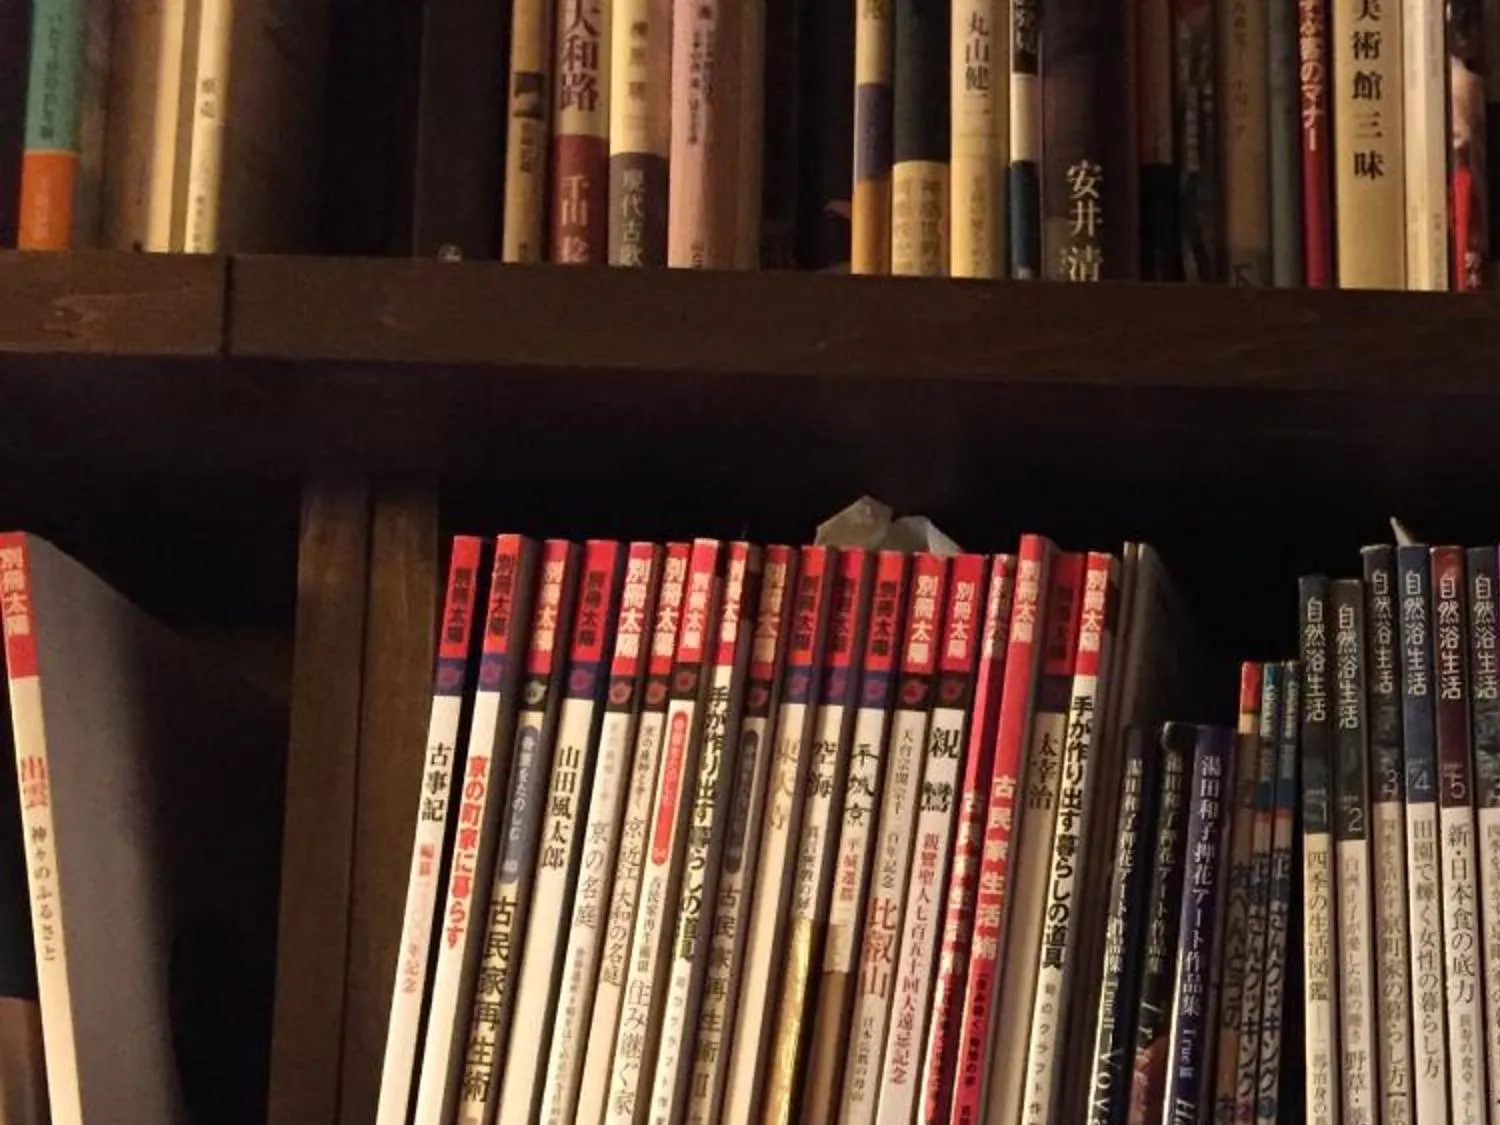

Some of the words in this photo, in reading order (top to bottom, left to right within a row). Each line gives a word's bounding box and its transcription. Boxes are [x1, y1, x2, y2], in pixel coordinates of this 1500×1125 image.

[1061, 158, 1104, 284] 安井清
[1302, 596, 1328, 723] 自然浴生活
[1336, 603, 1360, 730] 自然浴生活
[1403, 569, 1429, 697] 自然浴生活
[1437, 574, 1463, 701] 自然浴生活
[1472, 574, 1499, 701] 自然浴生活
[420, 740, 454, 823] 古事記
[540, 743, 582, 871] 山田風太郎
[845, 740, 881, 828] 平城京
[920, 726, 962, 814] 親鸞
[445, 754, 490, 950] 京の町家に暮らす
[1447, 822, 1476, 1006] 新・日本食の底力
[463, 895, 519, 1104] 古民家再生術
